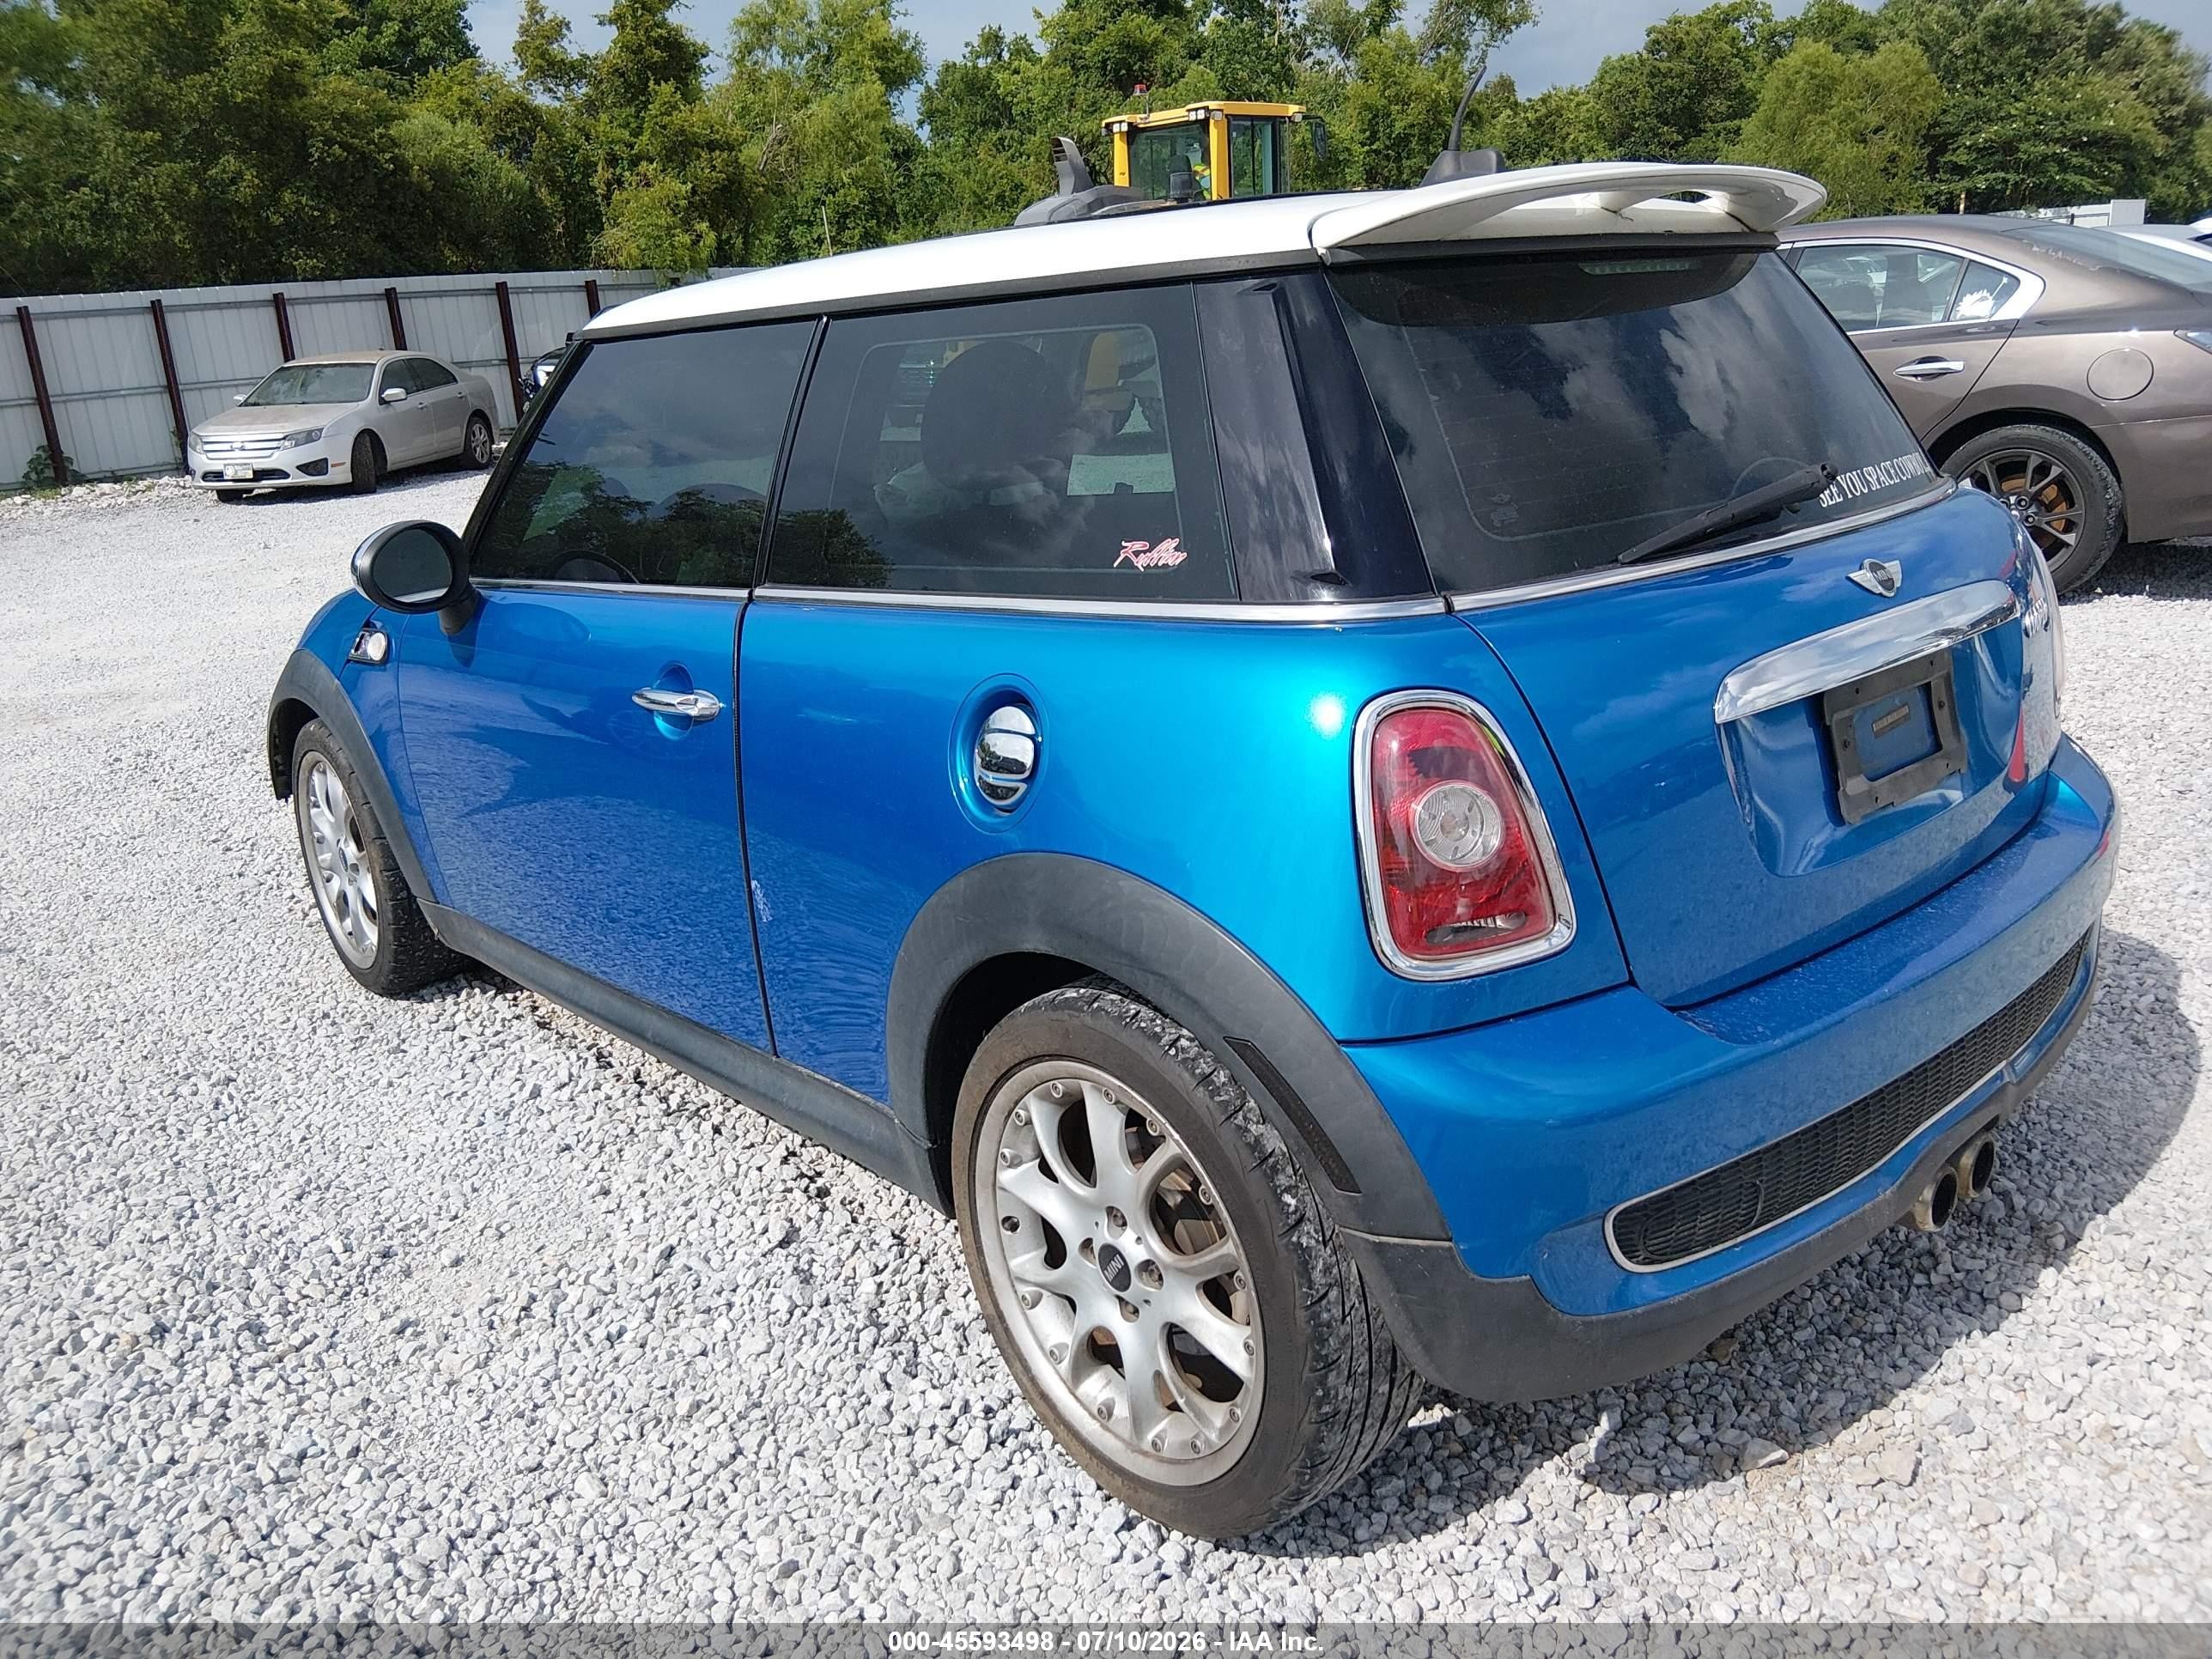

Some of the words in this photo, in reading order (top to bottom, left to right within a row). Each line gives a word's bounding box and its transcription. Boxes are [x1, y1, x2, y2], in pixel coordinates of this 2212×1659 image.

[1819, 481, 1844, 508] SEE
[1836, 470, 1869, 499] YOU
[1863, 460, 1900, 491] SPACE
[1104, 1254, 1125, 1283] MINI
